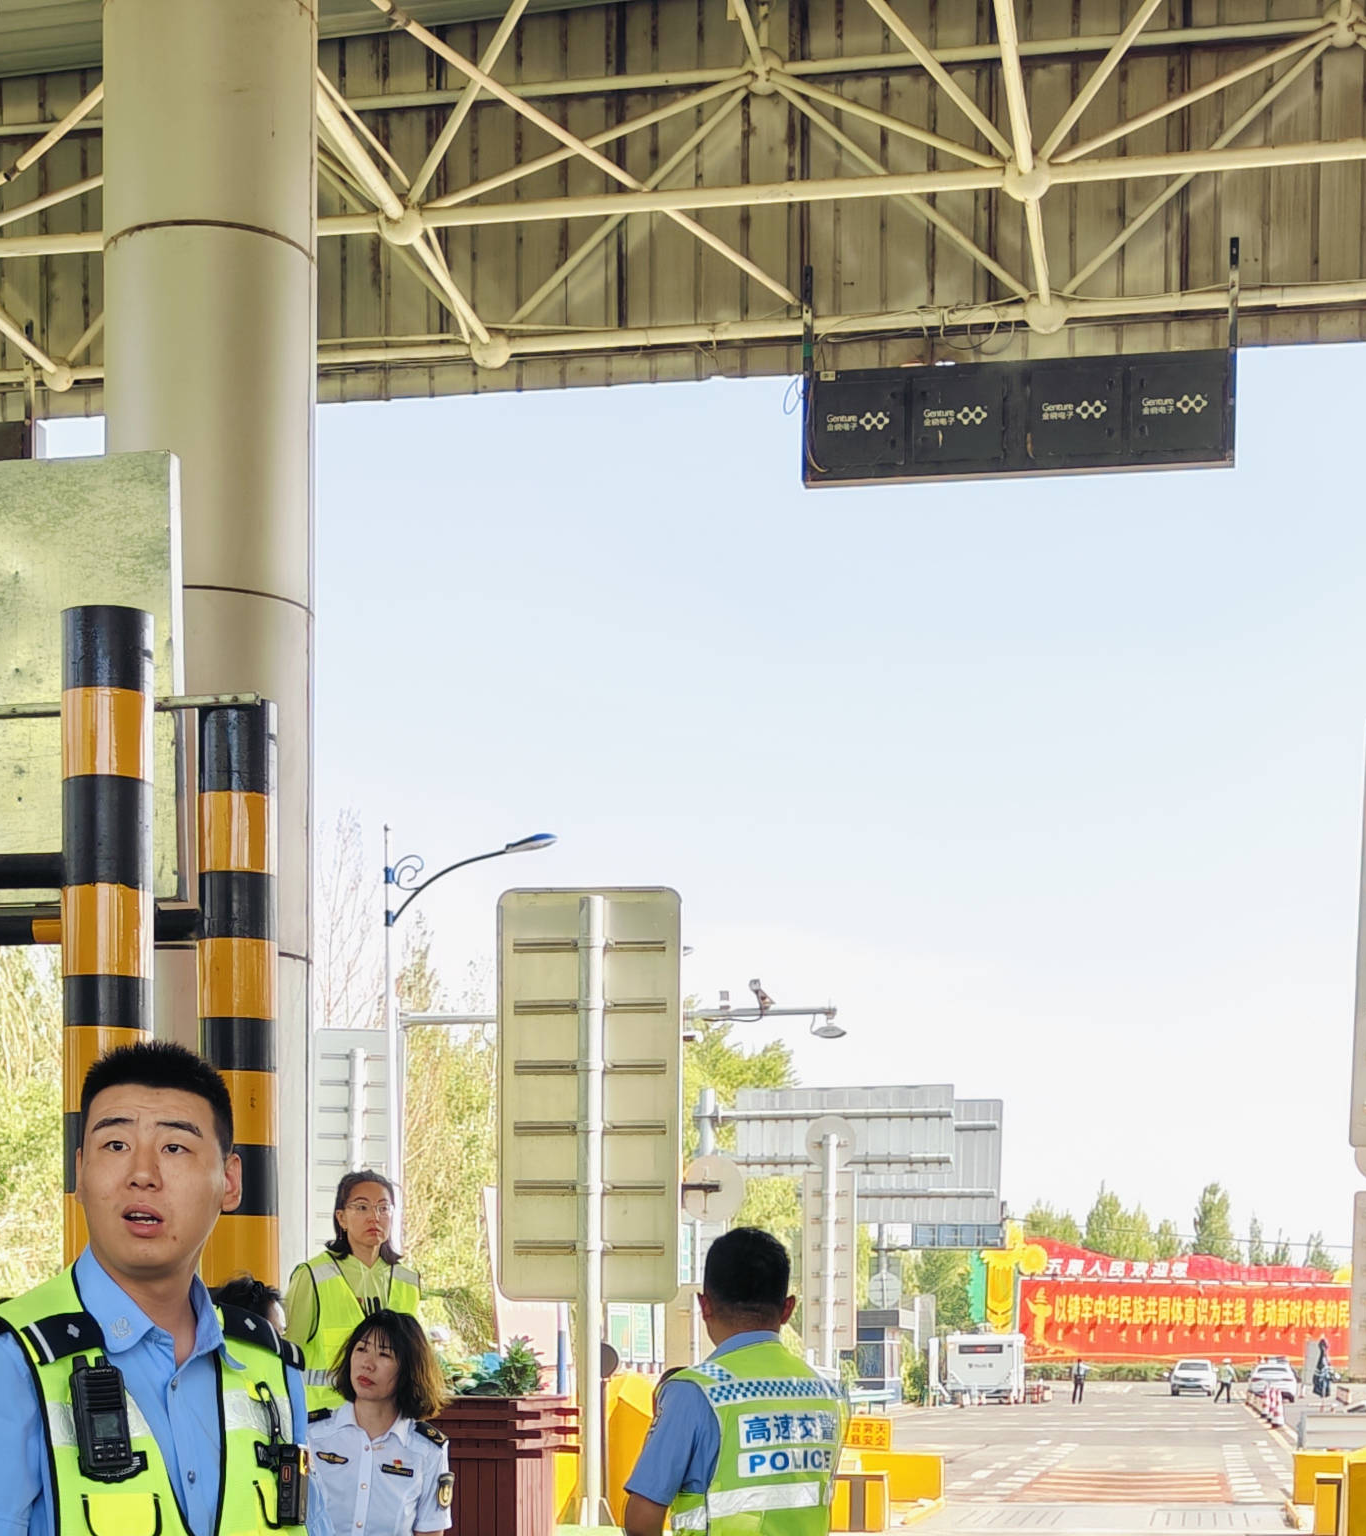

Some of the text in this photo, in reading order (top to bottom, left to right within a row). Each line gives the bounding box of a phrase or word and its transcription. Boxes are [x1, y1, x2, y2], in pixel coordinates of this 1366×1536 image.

[1041, 402, 1074, 412] Genture
[1141, 397, 1175, 407] Genture
[923, 408, 955, 418] Genture
[826, 414, 857, 423] Genture
[1054, 1293, 1350, 1329] 以铸牢中华民族共同体意识为主线 推动新时代党的民
[743, 1412, 835, 1444] 高速交警
[749, 1450, 831, 1473] POLICE
